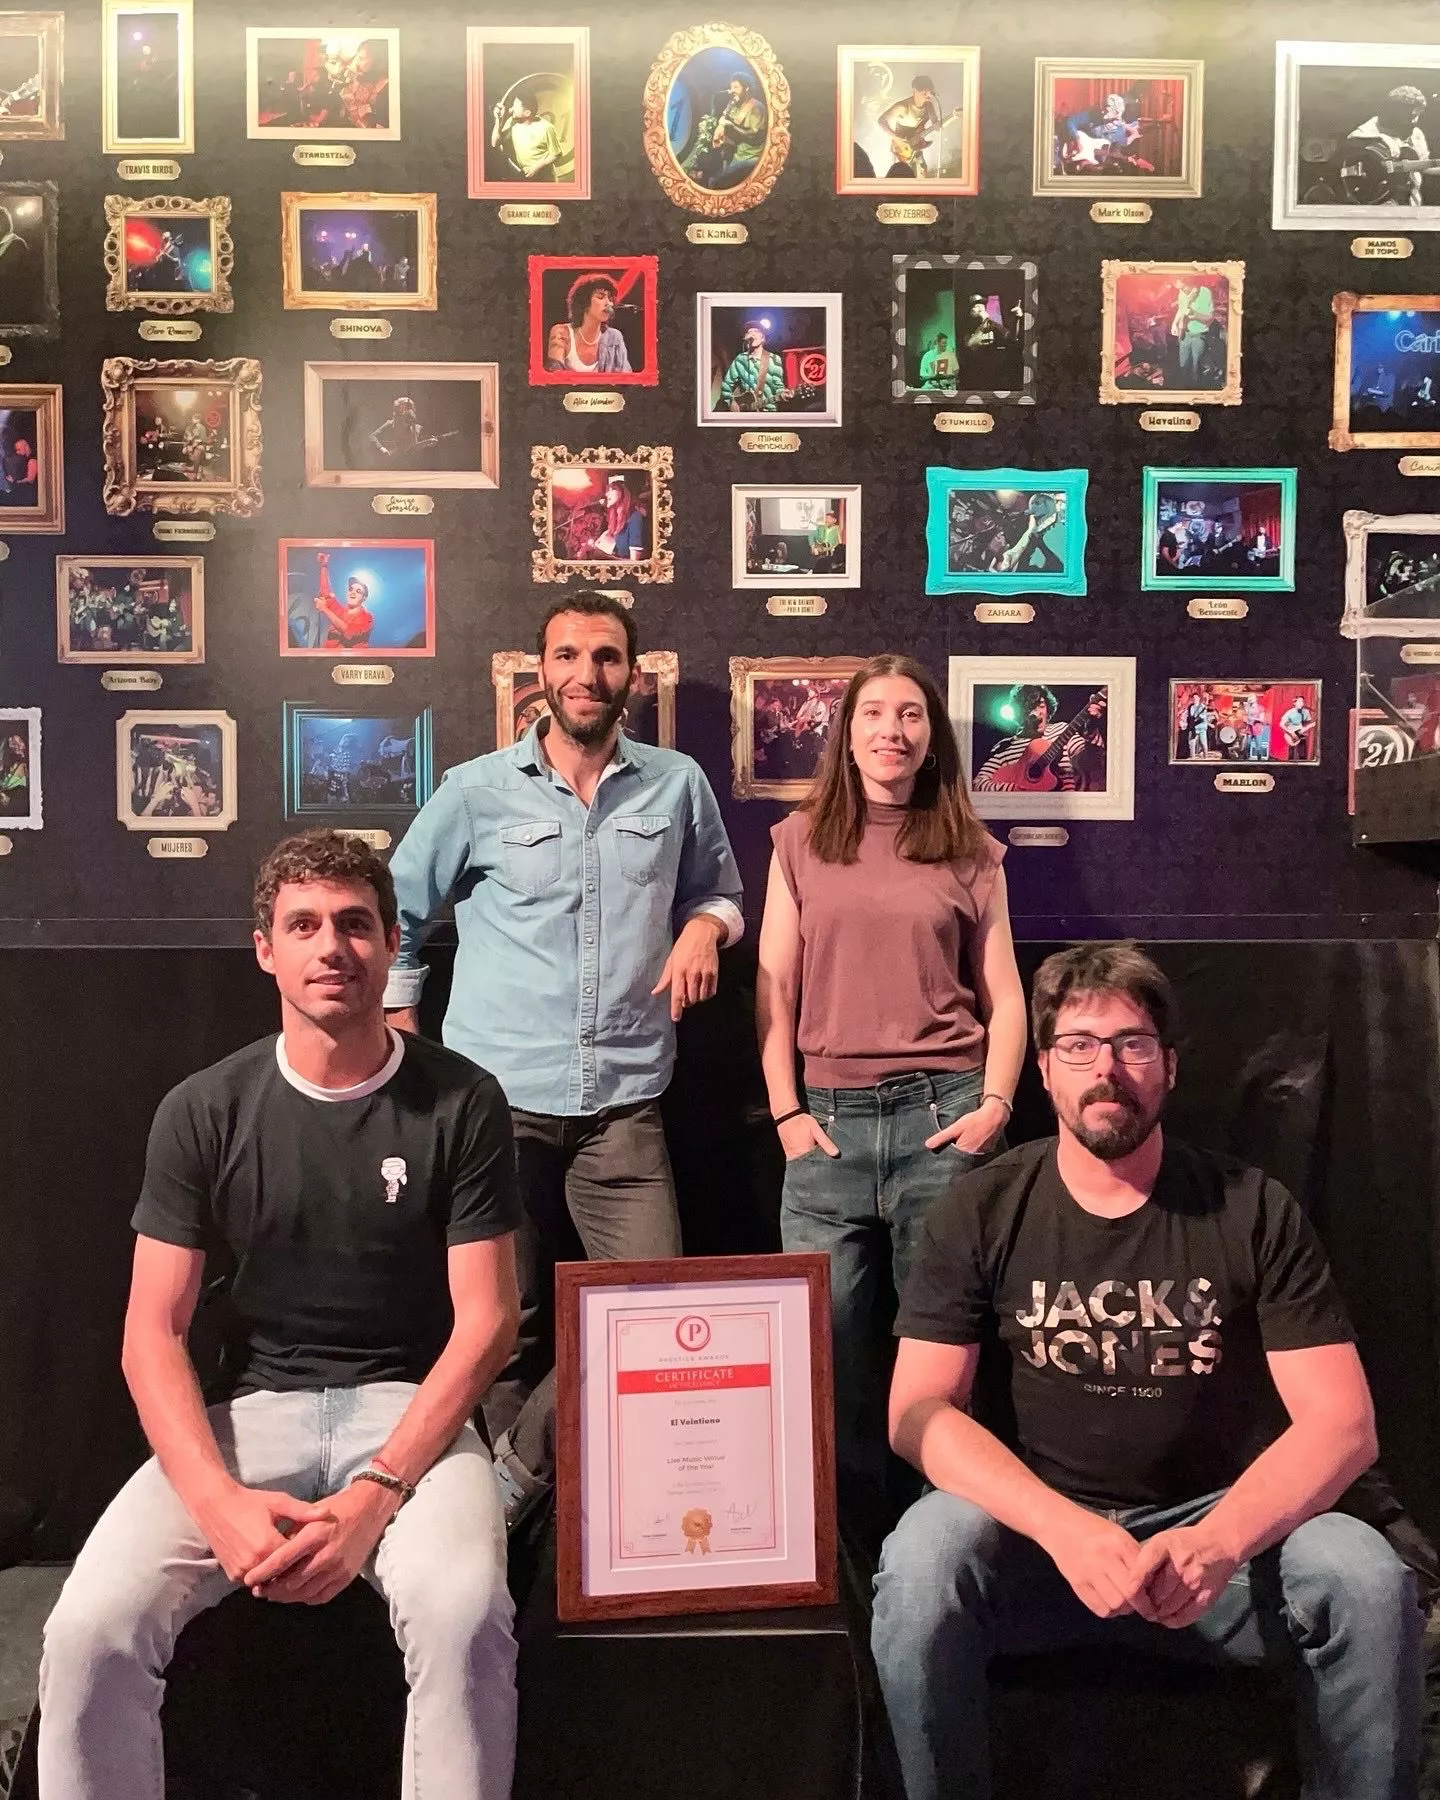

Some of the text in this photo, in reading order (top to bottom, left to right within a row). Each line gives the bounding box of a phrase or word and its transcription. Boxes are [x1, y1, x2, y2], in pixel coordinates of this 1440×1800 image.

[125, 165, 174, 175] TRAVIS BIRDS
[507, 210, 553, 219] GRANDE AMORE
[883, 208, 931, 218] SEXY ZEBRAS
[1098, 208, 1144, 217] Mark Olson
[696, 229, 738, 239] El Kanka
[339, 325, 383, 333] SHINOVA
[573, 398, 615, 406] Alice Wonder
[1148, 416, 1192, 425] Havalina
[757, 434, 783, 442] Mikel
[747, 442, 793, 450] Erentxun
[987, 609, 1022, 617] ZAHARA
[341, 669, 385, 680] VARRY BRAVA
[1222, 779, 1267, 787] MARLON
[161, 843, 193, 853] MUJERES
[1020, 1329, 1223, 1376] JONES
[655, 1368, 734, 1383] CERTIFICATE
[670, 1417, 721, 1426] El Veintiuno
